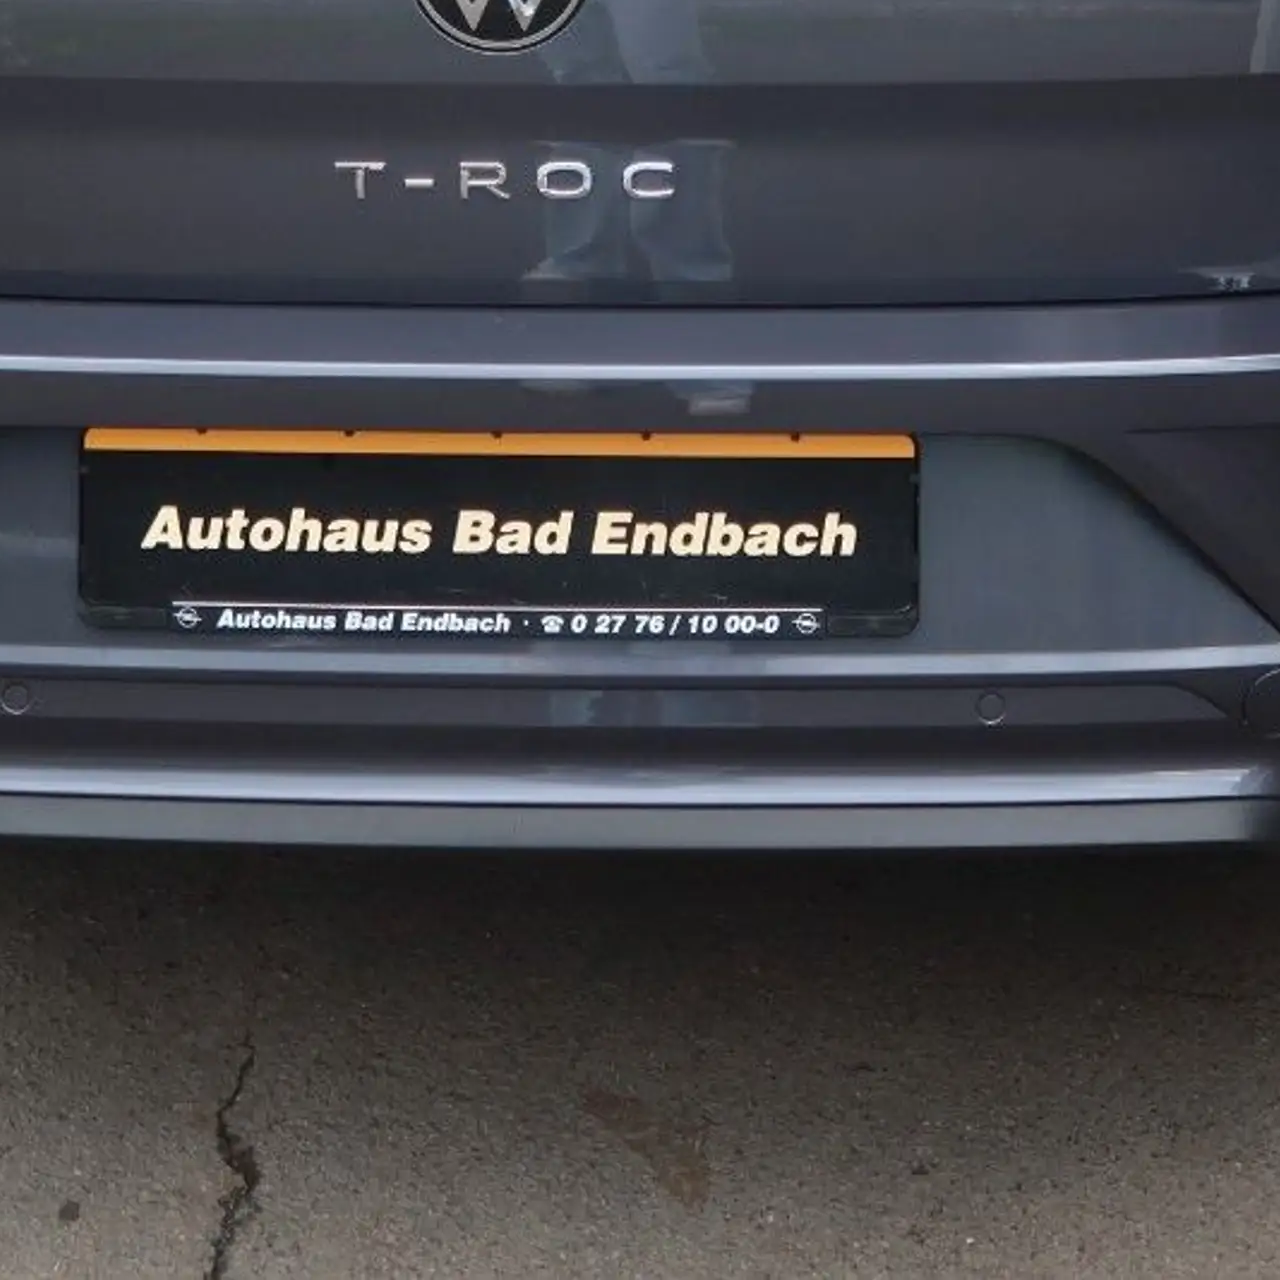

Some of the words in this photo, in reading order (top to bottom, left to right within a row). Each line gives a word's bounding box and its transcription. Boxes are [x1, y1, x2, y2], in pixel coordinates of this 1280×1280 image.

[334, 160, 676, 199] T-ROC
[140, 505, 433, 554] Autohaus
[452, 509, 574, 555] Bad
[590, 510, 858, 557] Endbach
[217, 608, 337, 630] Autohaus
[344, 611, 394, 632] Bad
[400, 612, 511, 634] Endbach
[570, 614, 588, 634] 0
[593, 614, 628, 634] 27
[634, 614, 665, 635] 76
[687, 614, 718, 635] 10
[723, 614, 780, 635] 00-0
